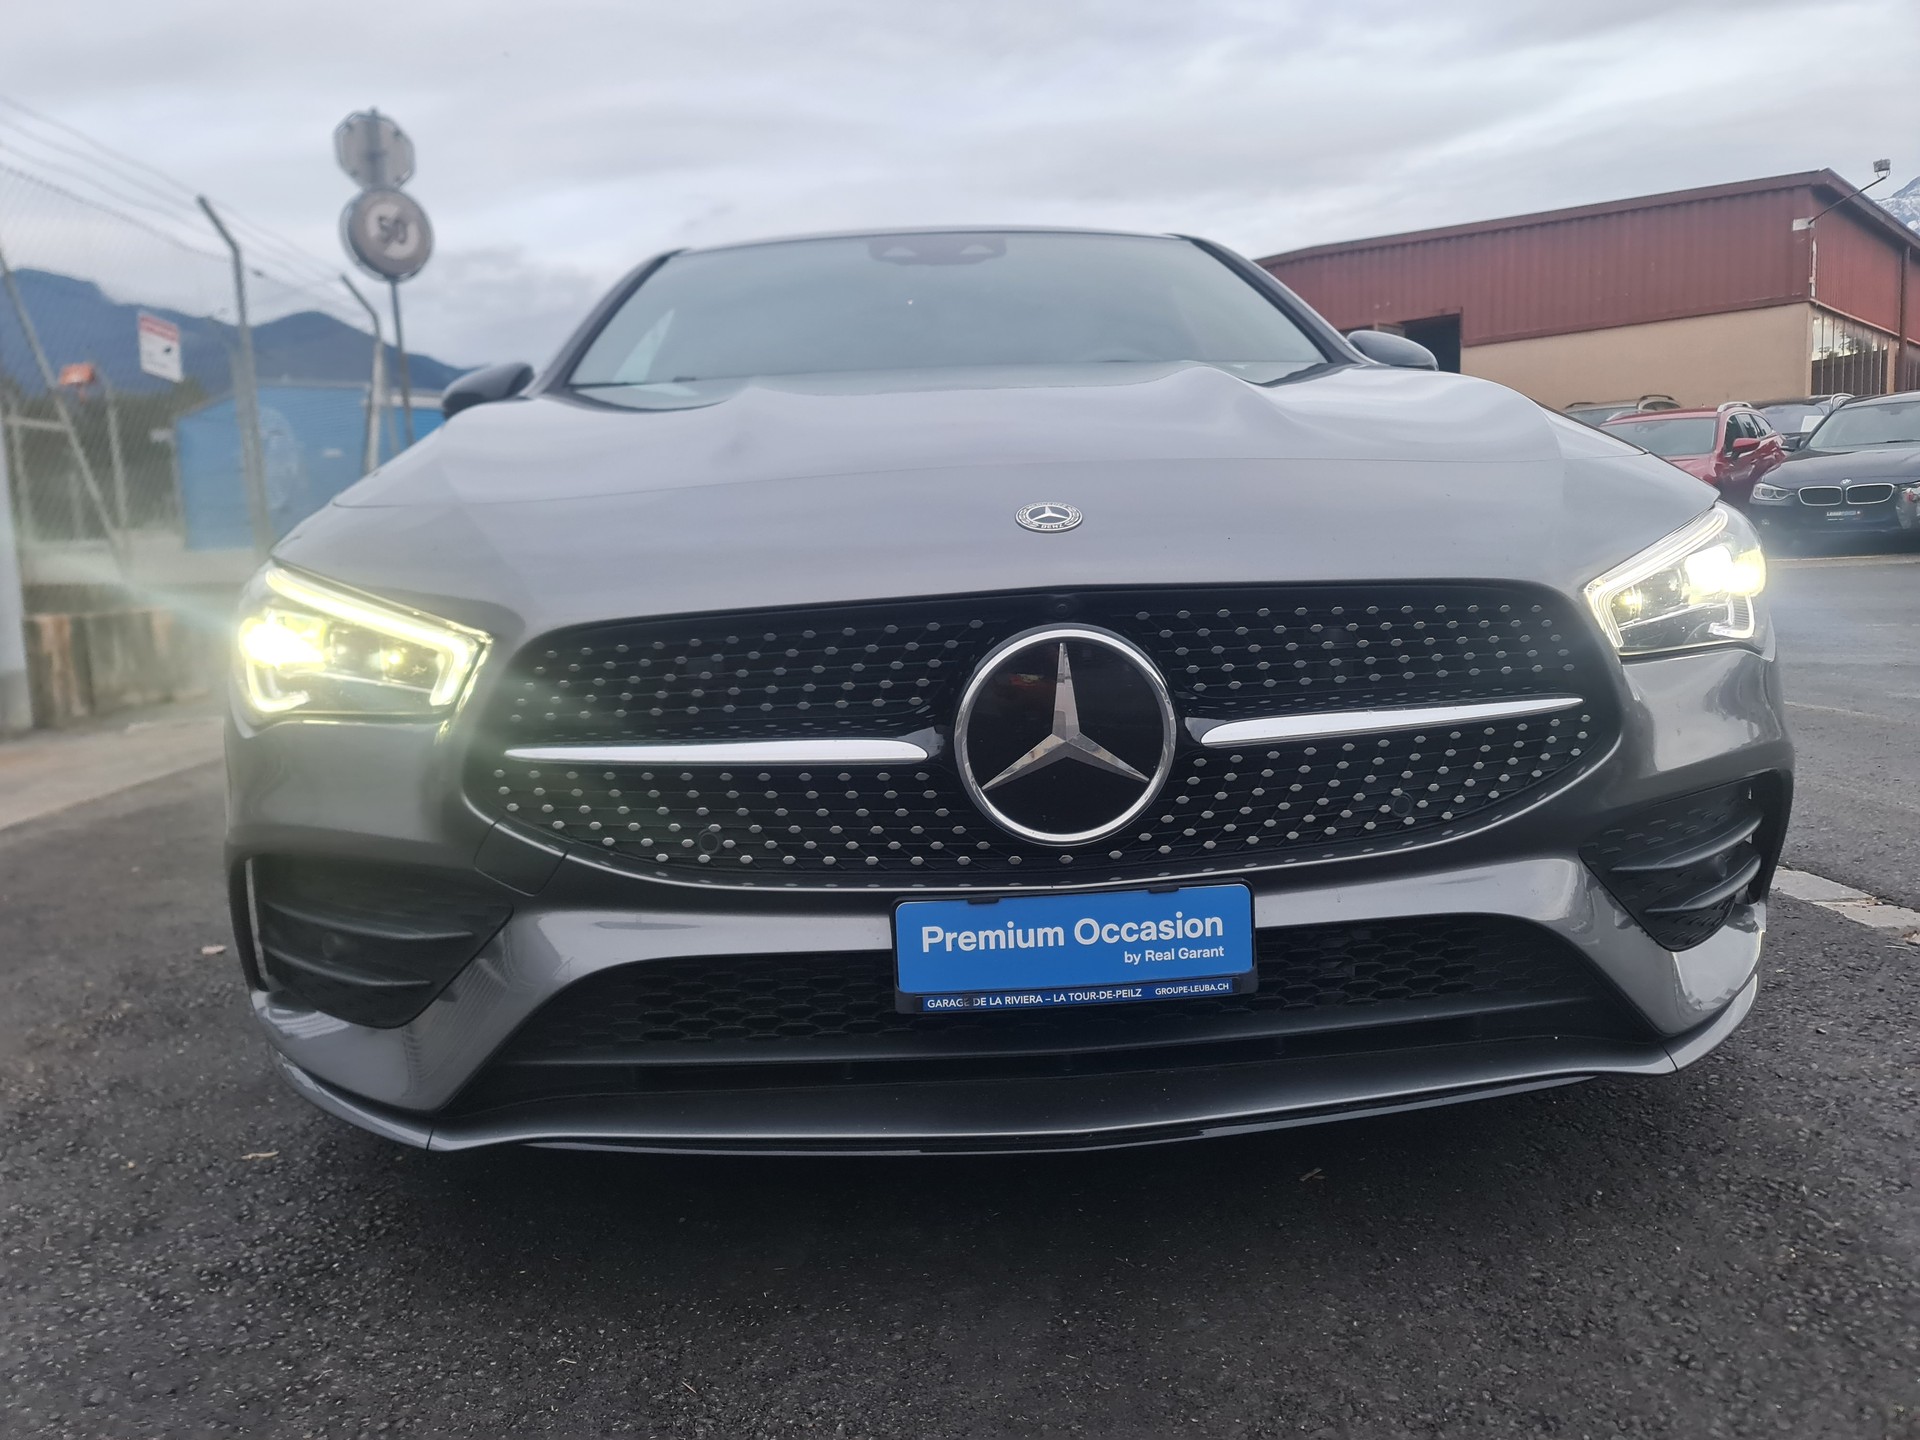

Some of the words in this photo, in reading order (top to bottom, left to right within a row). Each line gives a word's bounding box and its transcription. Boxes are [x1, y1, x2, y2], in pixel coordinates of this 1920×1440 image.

[922, 920, 1065, 953] Premium
[1074, 911, 1223, 945] Occasion
[1124, 950, 1141, 966] by
[1145, 948, 1175, 962] Real
[1178, 945, 1225, 960] Garant
[973, 997, 987, 1006] DE
[989, 996, 1002, 1006] LA
[1005, 995, 1043, 1005] RIVIERA
[1053, 993, 1066, 1003] LA
[1068, 988, 1142, 1002] TOUR-DE-PEILZ
[1155, 983, 1229, 996] GROUPE-LEUBA.CH
